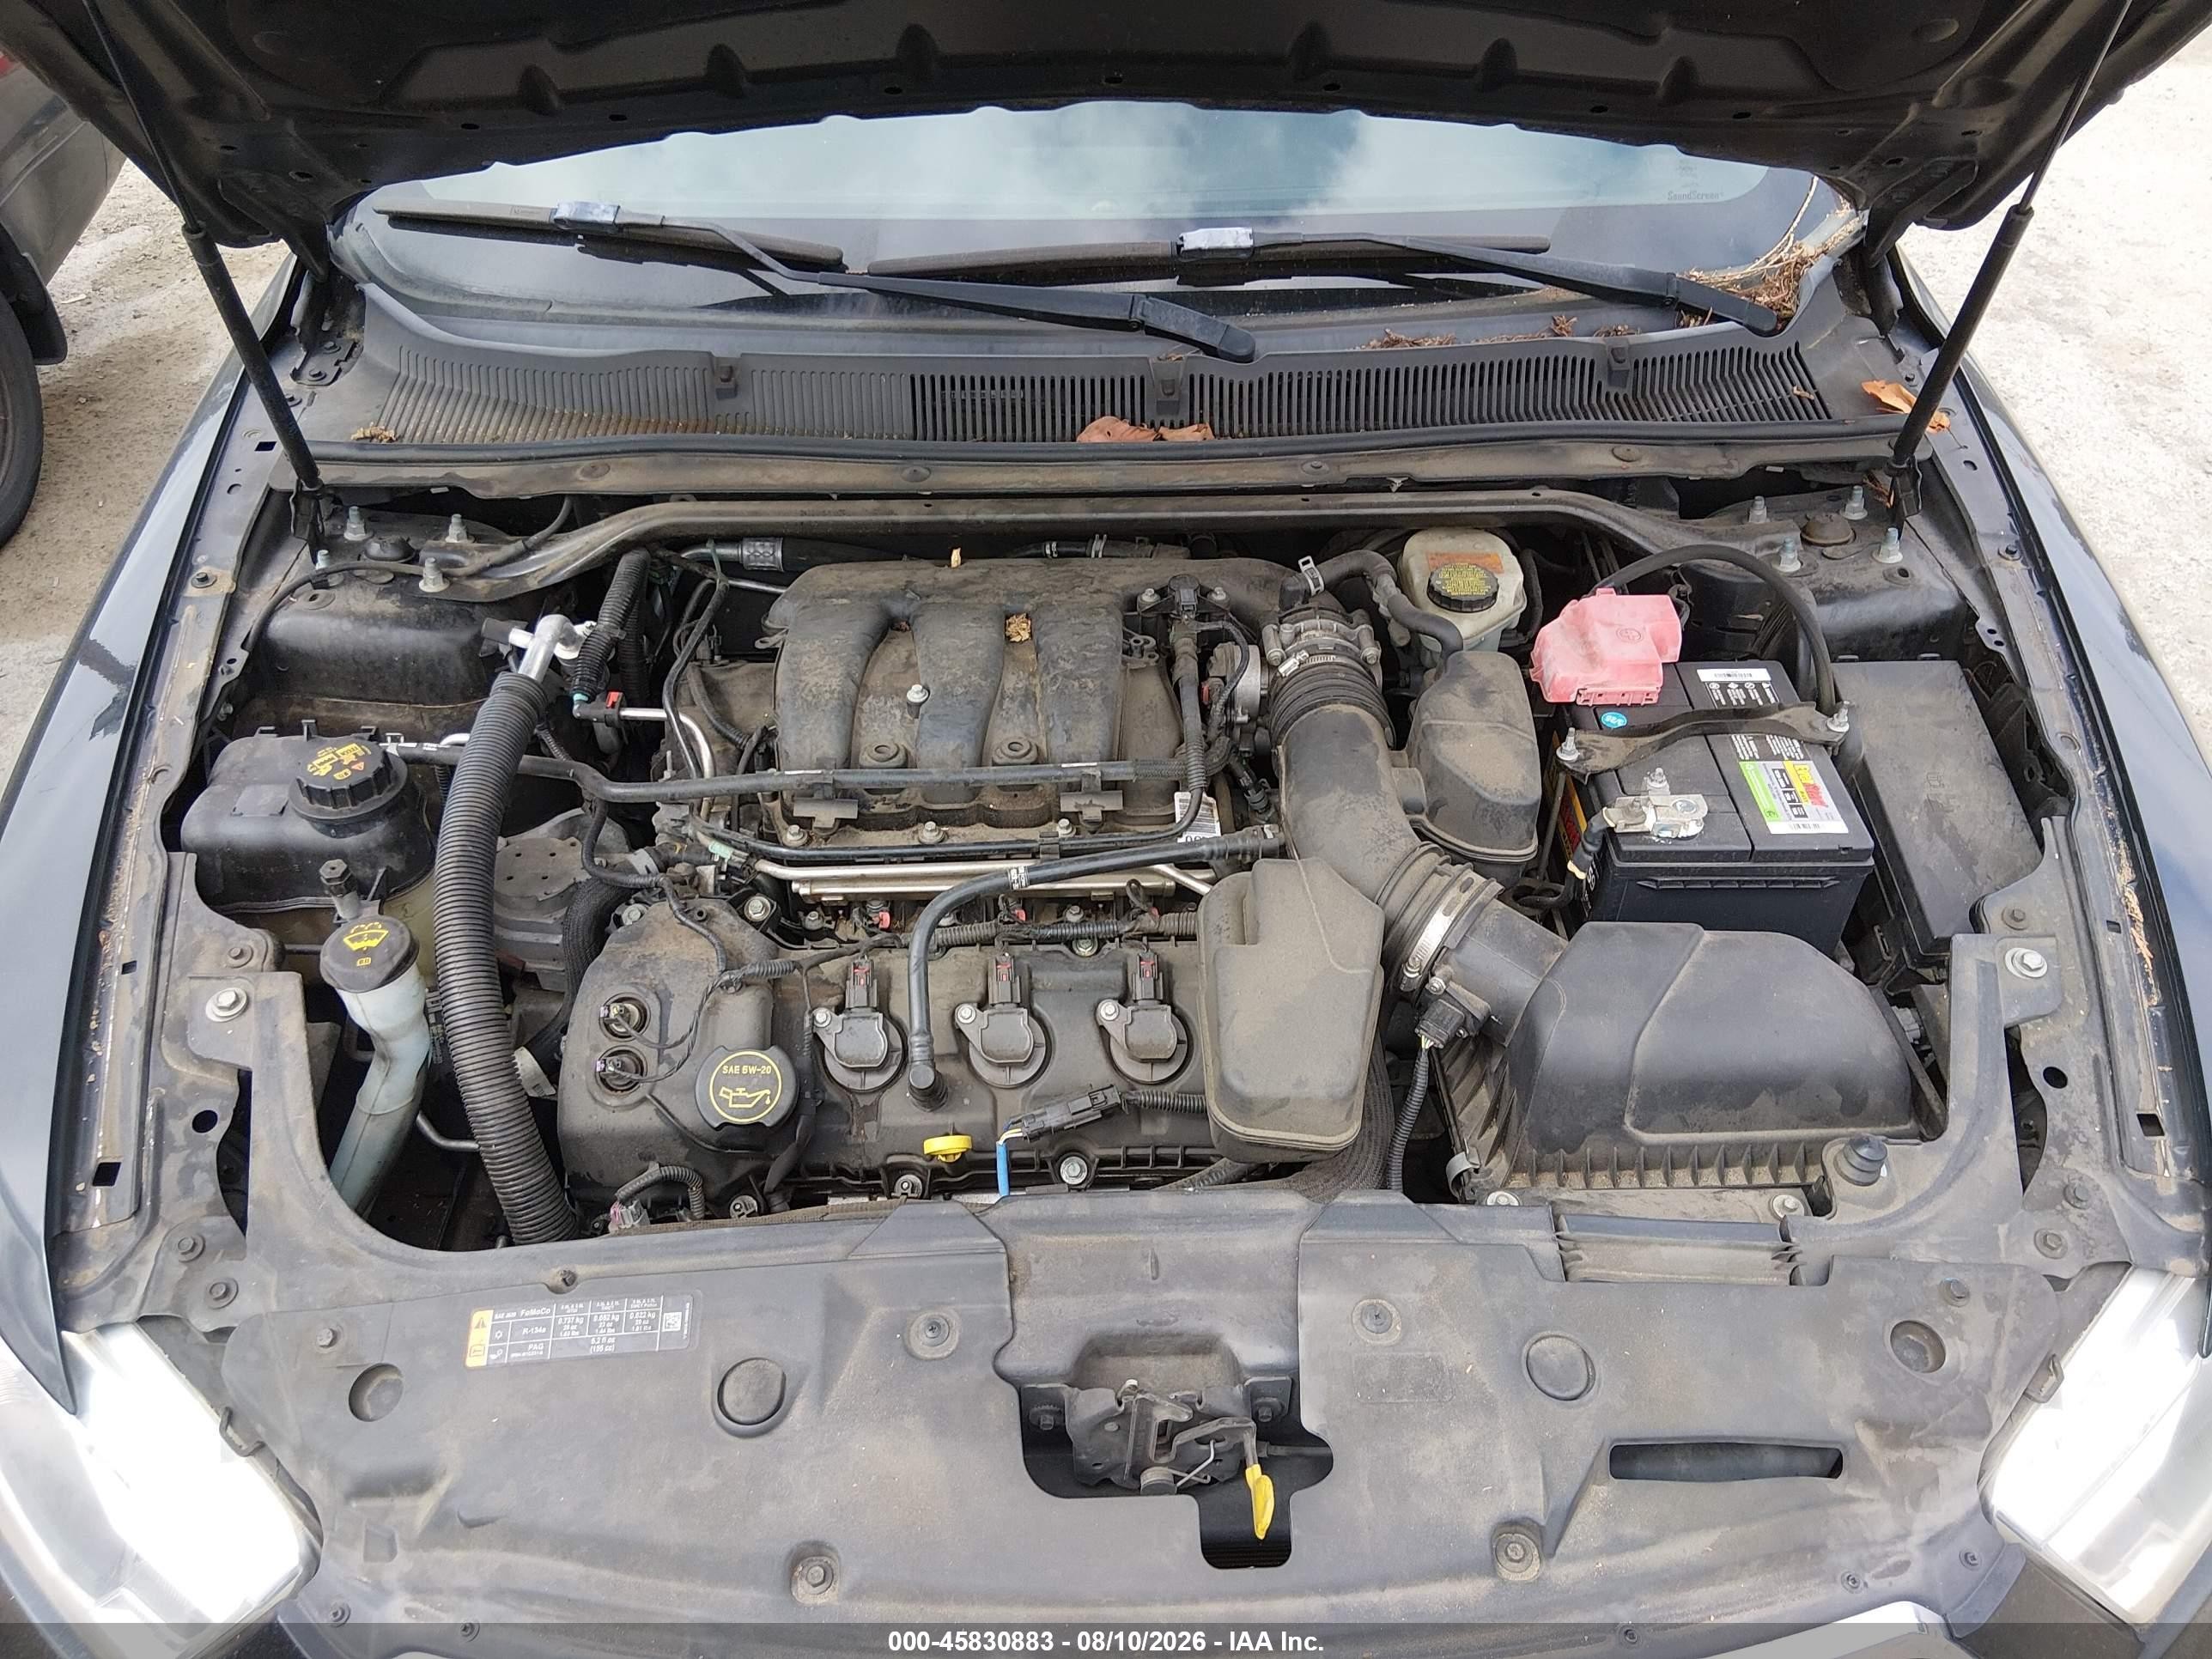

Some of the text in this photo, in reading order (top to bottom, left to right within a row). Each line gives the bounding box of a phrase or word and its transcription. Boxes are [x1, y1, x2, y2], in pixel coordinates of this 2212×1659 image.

[721, 1065, 772, 1075] SAE 5W-20
[520, 1307, 551, 1317] FoMoCo
[647, 1311, 656, 1320] kg
[575, 1316, 585, 1325] kg
[611, 1313, 620, 1322] kg
[521, 1326, 547, 1335] R-134a
[527, 1343, 544, 1352] PAG
